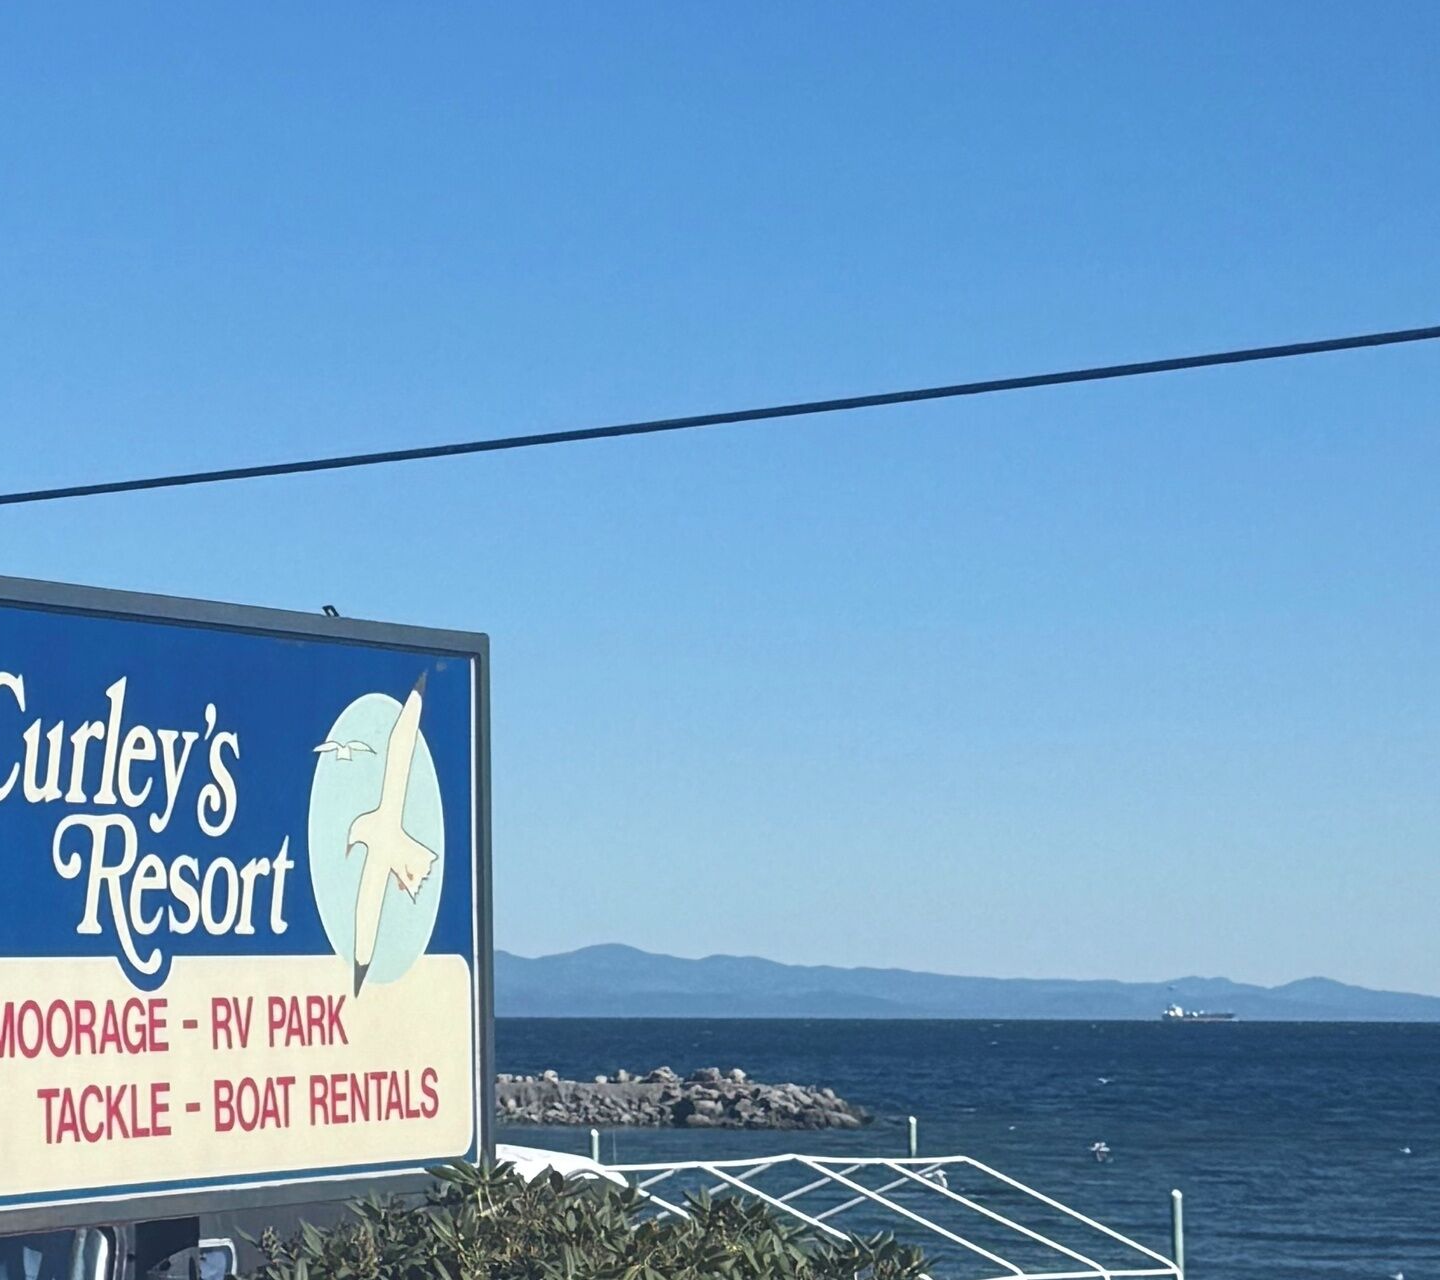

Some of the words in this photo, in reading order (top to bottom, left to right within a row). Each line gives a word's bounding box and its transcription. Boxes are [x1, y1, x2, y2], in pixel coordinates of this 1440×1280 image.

[52, 813, 294, 974] Resort
[182, 1019, 198, 1029] -
[211, 996, 254, 1049] RV
[268, 994, 349, 1047] PARK
[37, 1082, 172, 1144] TACKLE
[185, 1102, 200, 1112] -
[214, 1076, 296, 1132] BOAT
[309, 1067, 440, 1126] RENTALS
